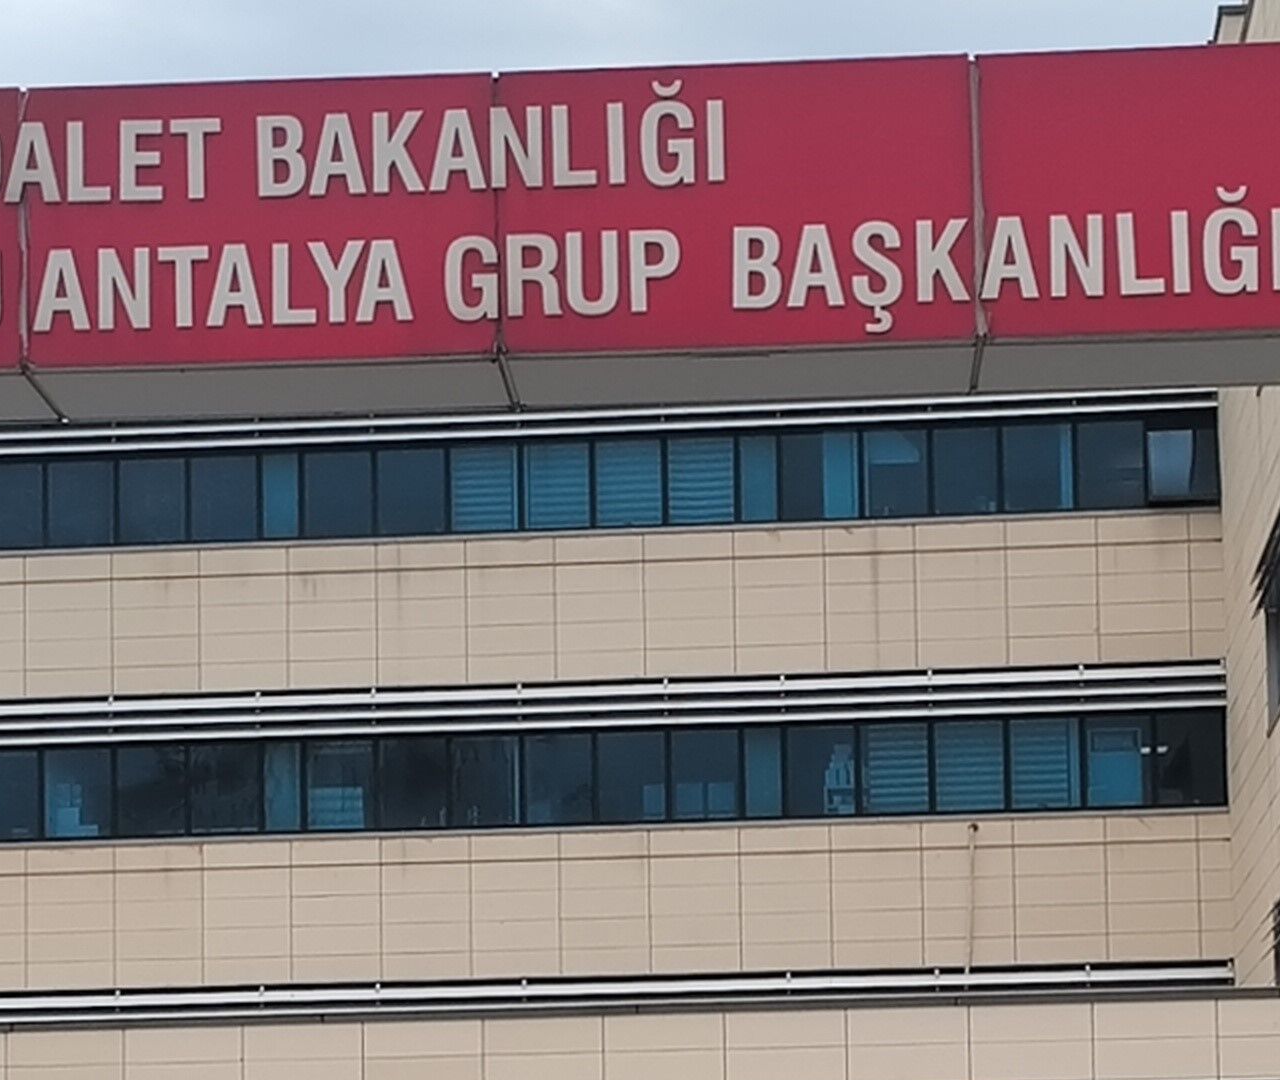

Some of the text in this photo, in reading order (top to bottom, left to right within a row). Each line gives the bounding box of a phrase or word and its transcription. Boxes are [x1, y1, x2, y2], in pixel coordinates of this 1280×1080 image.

[256, 79, 726, 198] BAKANLIĞI
[32, 238, 414, 333] ANTALYA
[444, 229, 681, 322] GRUP
